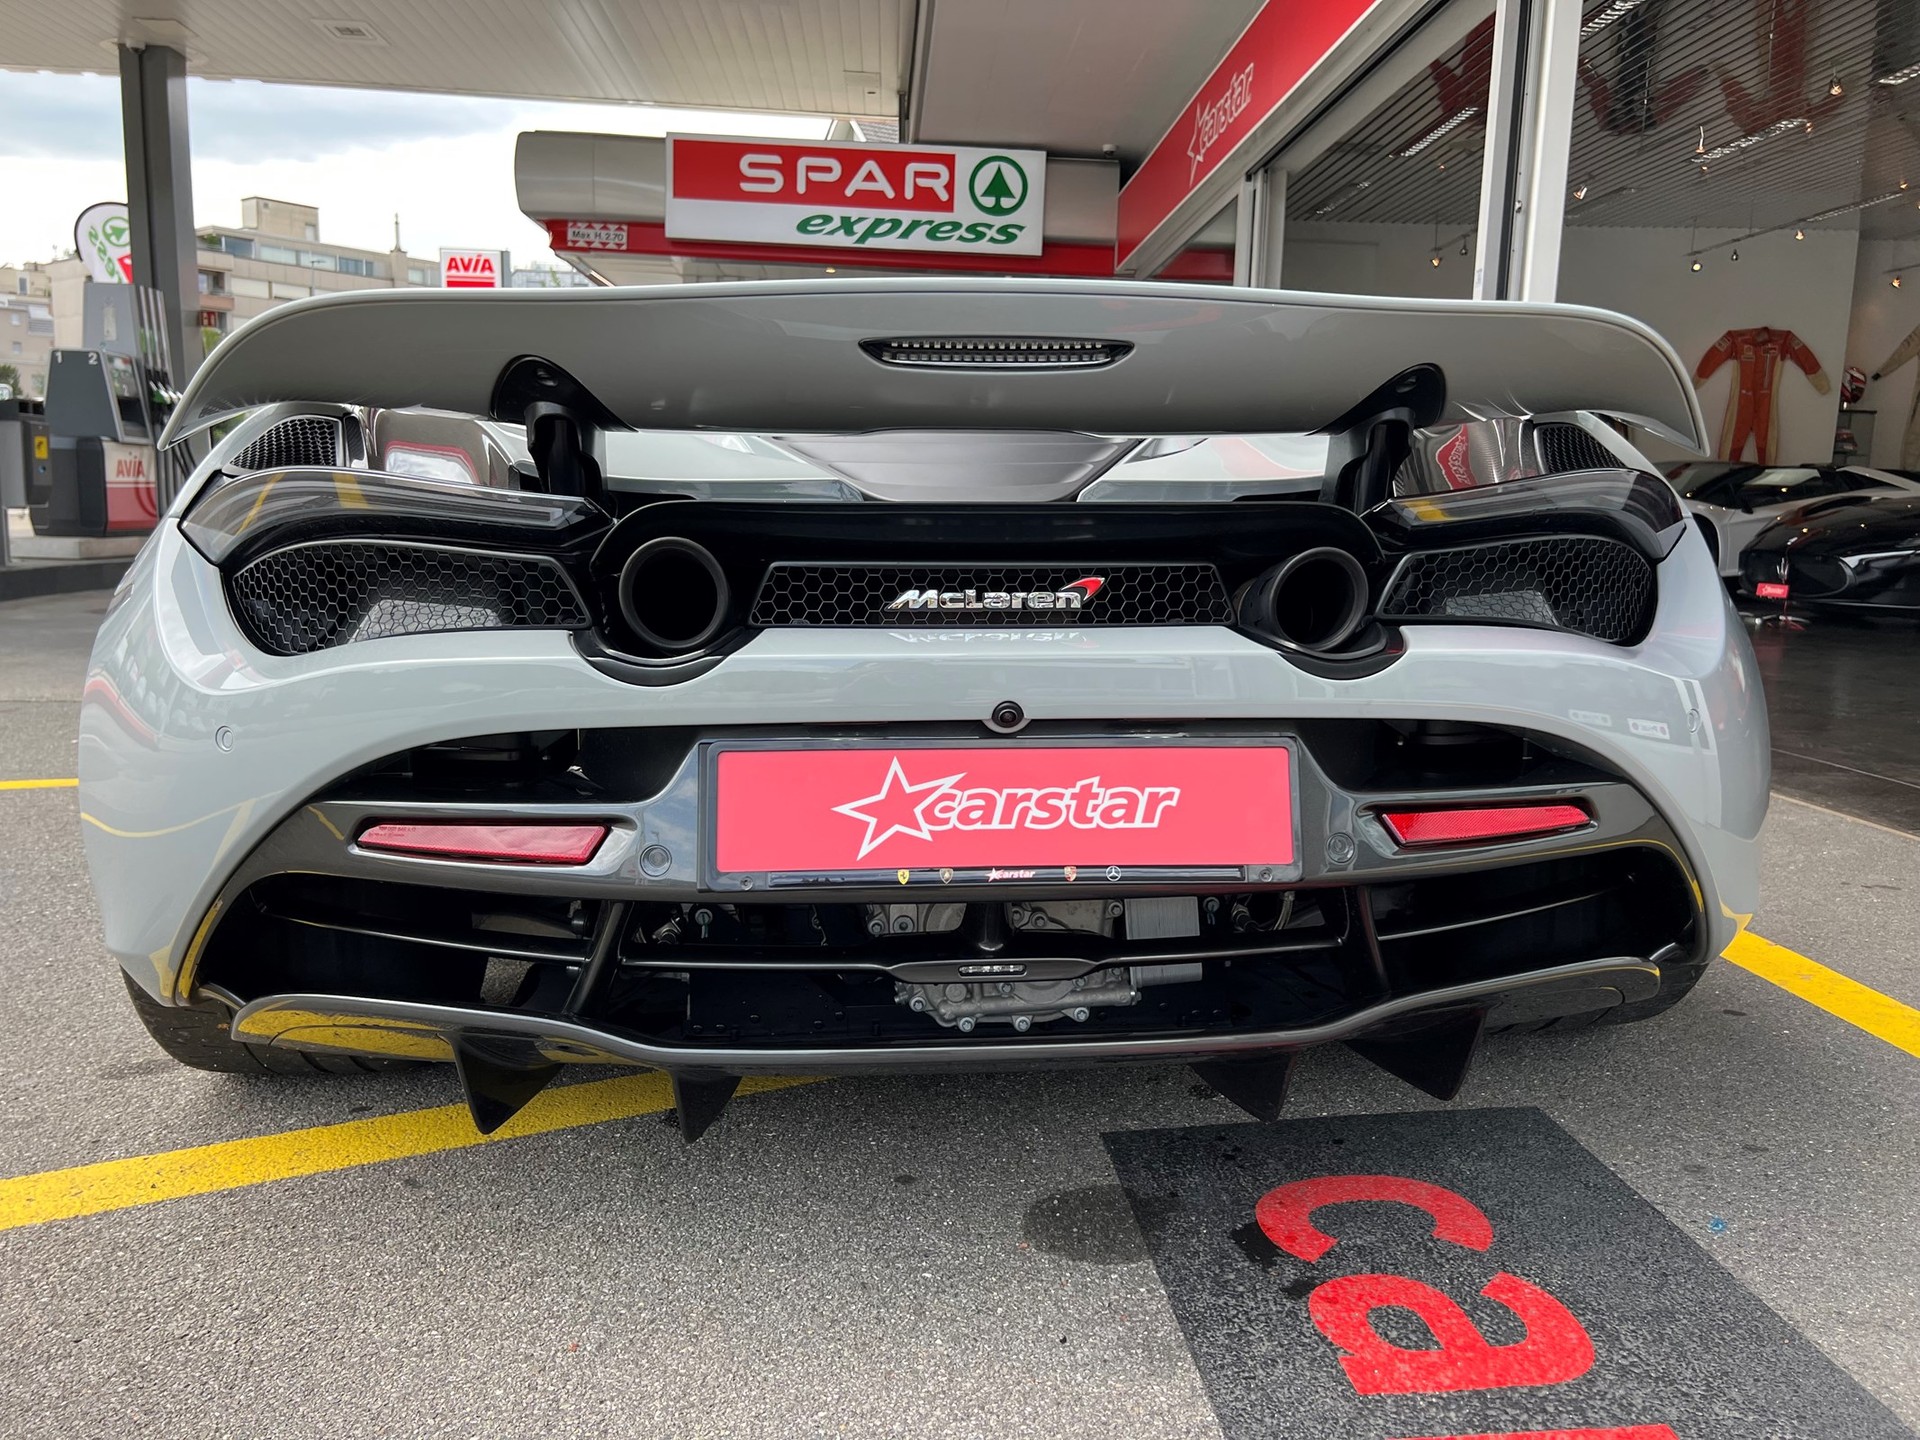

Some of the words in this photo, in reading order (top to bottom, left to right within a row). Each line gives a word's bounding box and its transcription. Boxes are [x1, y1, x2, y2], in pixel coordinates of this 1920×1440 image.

[739, 153, 950, 202] SPAR
[572, 230, 591, 239] Max
[796, 213, 1028, 245] express
[55, 351, 63, 364] 1
[88, 353, 98, 365] 2
[885, 588, 1082, 610] McLaren
[919, 775, 1181, 831] carstar
[997, 869, 1036, 879] carstar
[1256, 1174, 1680, 1440] ca
